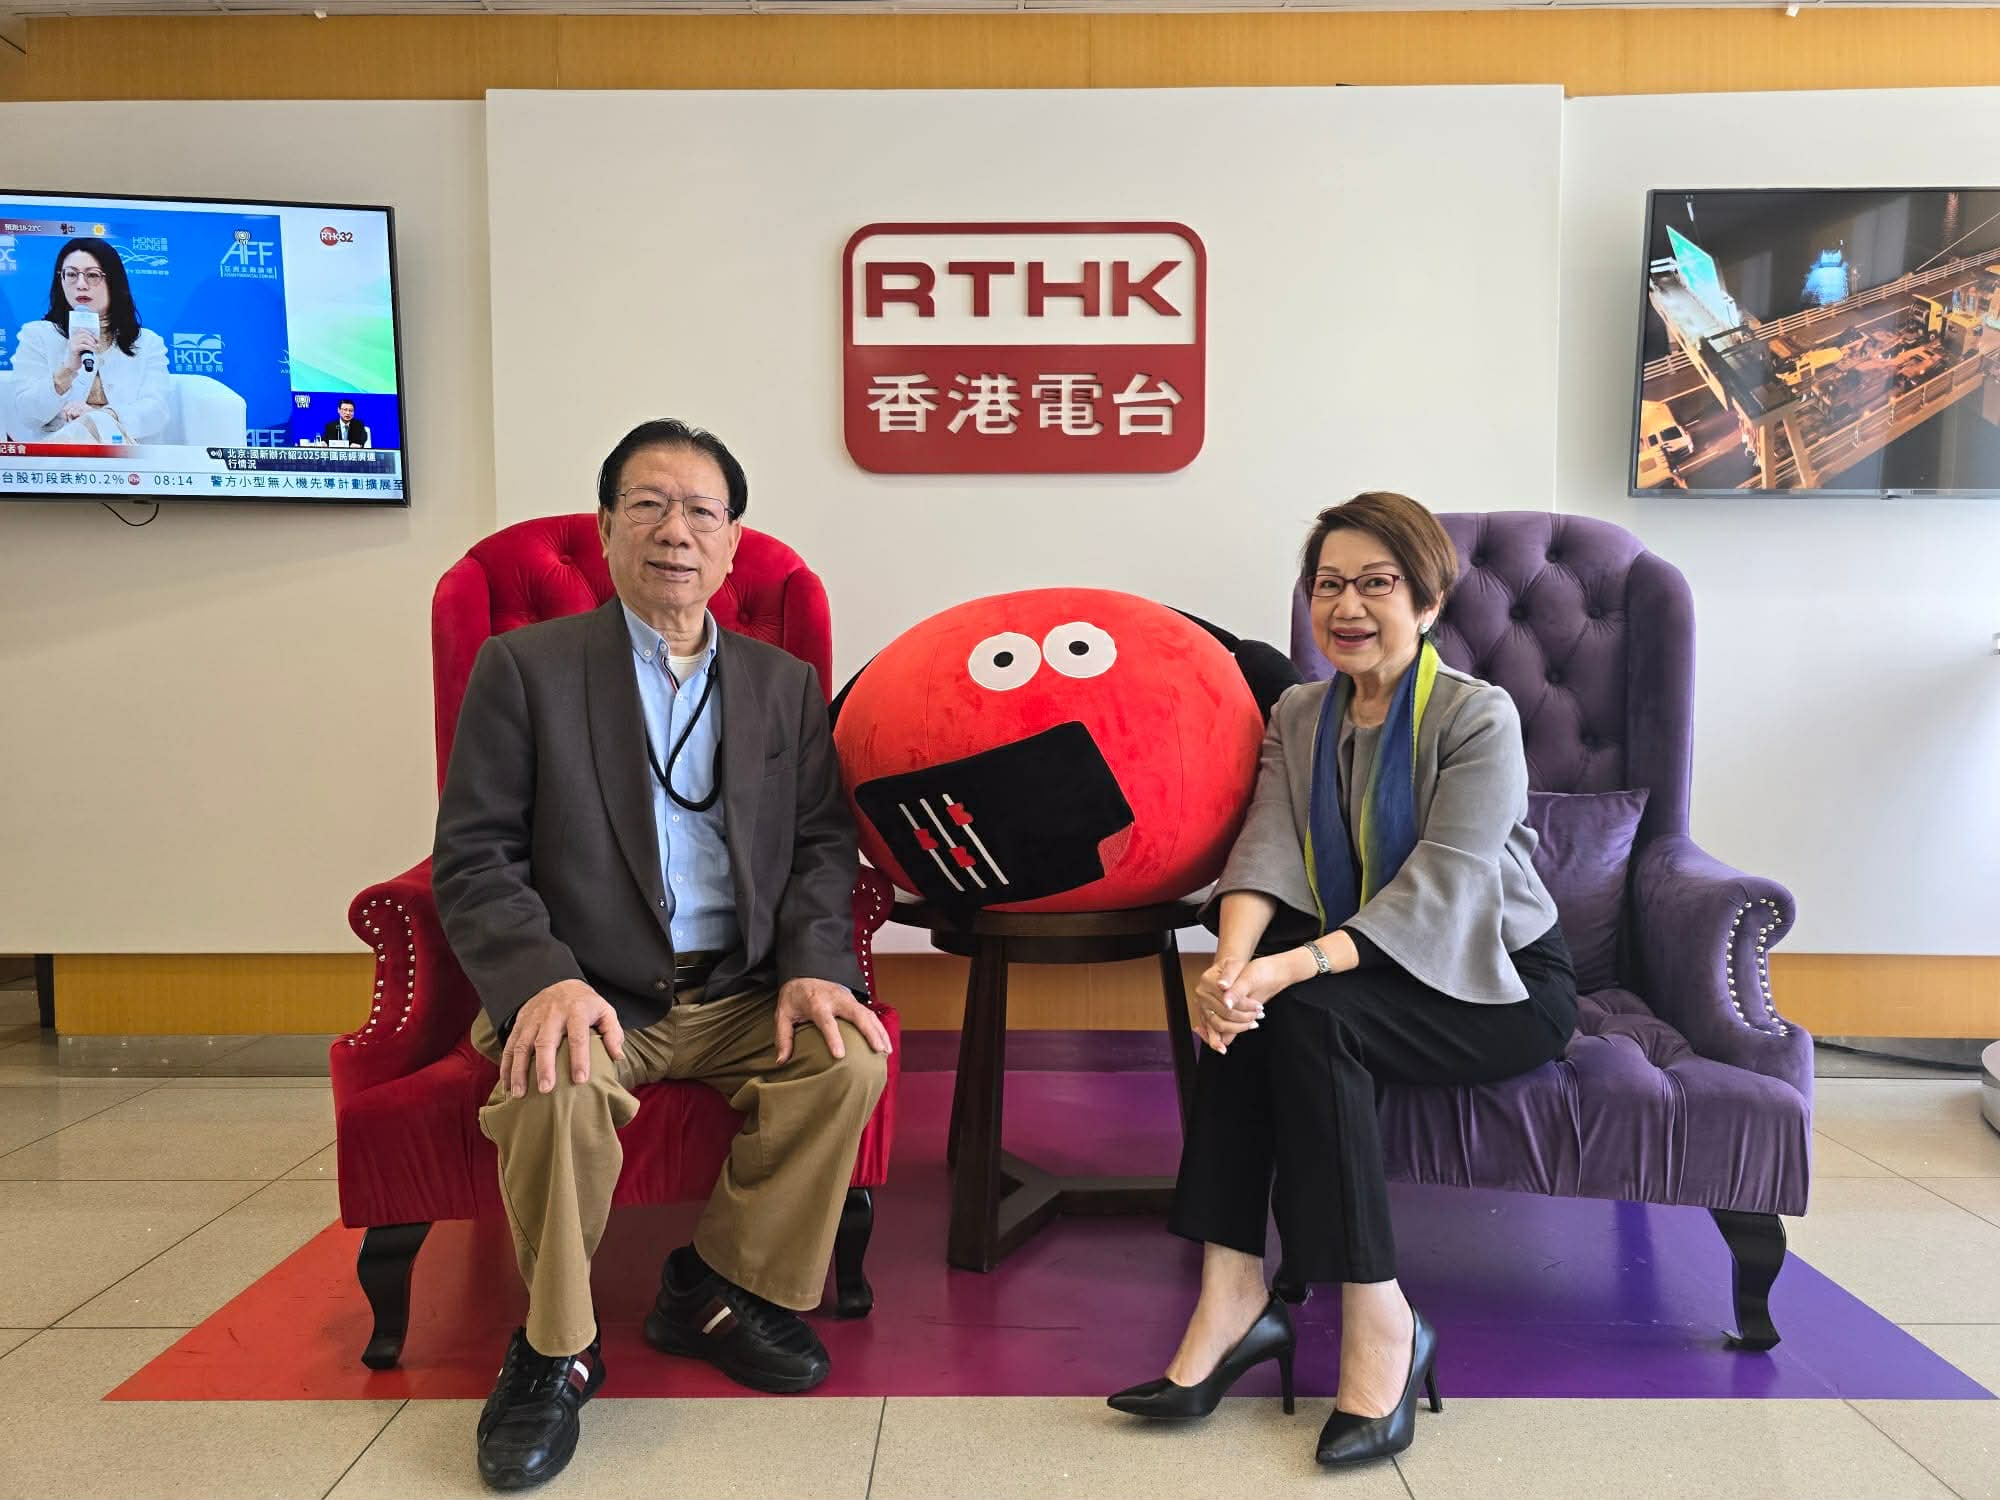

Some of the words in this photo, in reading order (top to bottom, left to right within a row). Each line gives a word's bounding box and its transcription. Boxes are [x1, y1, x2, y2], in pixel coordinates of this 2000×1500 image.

[221, 241, 274, 265] AFF
[865, 261, 1183, 318] RTHK
[173, 349, 223, 365] HKTDC
[867, 372, 1184, 436] 香港電台
[154, 475, 193, 486] 08:14
